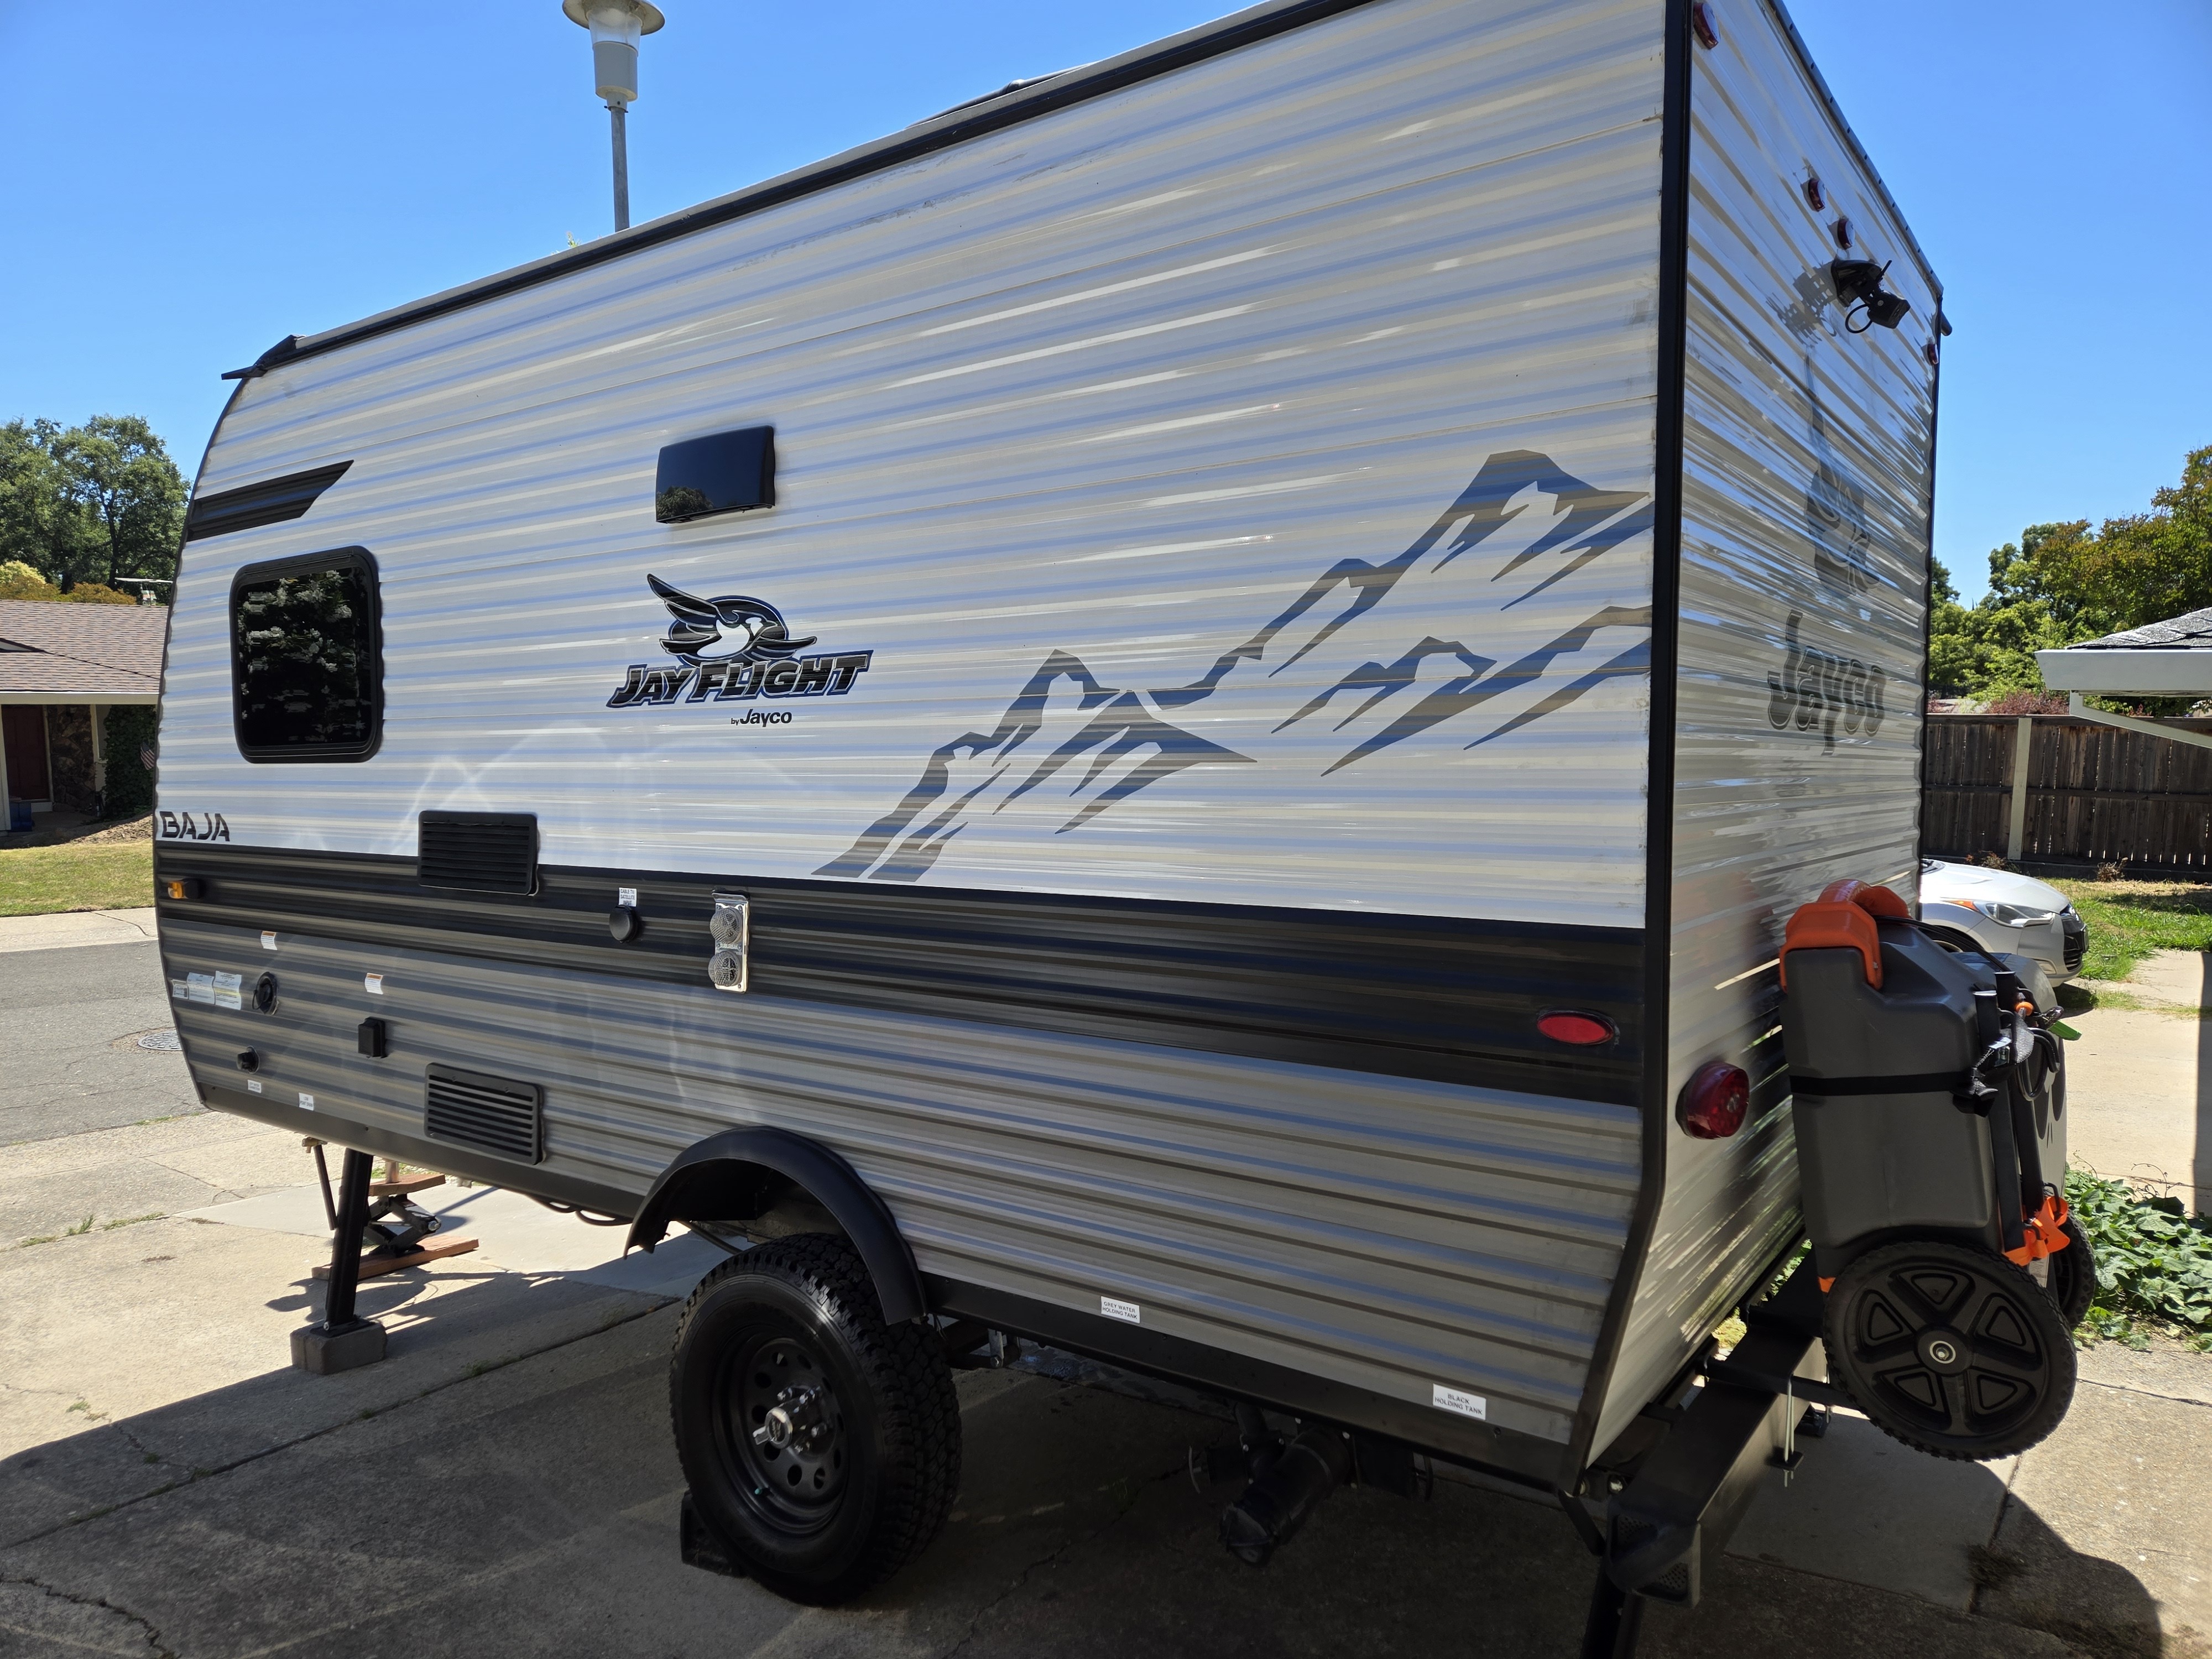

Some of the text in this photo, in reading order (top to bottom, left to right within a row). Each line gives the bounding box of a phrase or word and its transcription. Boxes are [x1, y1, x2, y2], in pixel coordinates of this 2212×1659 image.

[606, 650, 874, 708] JAY FLIGHT
[1766, 609, 1887, 756] Jayco
[740, 708, 792, 727] Jayco
[159, 811, 230, 842] BAJA
[1102, 1307, 1123, 1316] HOLDING
[1118, 1305, 1135, 1313] WATER
[1434, 1396, 1483, 1415] HOLDING TANK
[1447, 1393, 1470, 1405] BLACK
